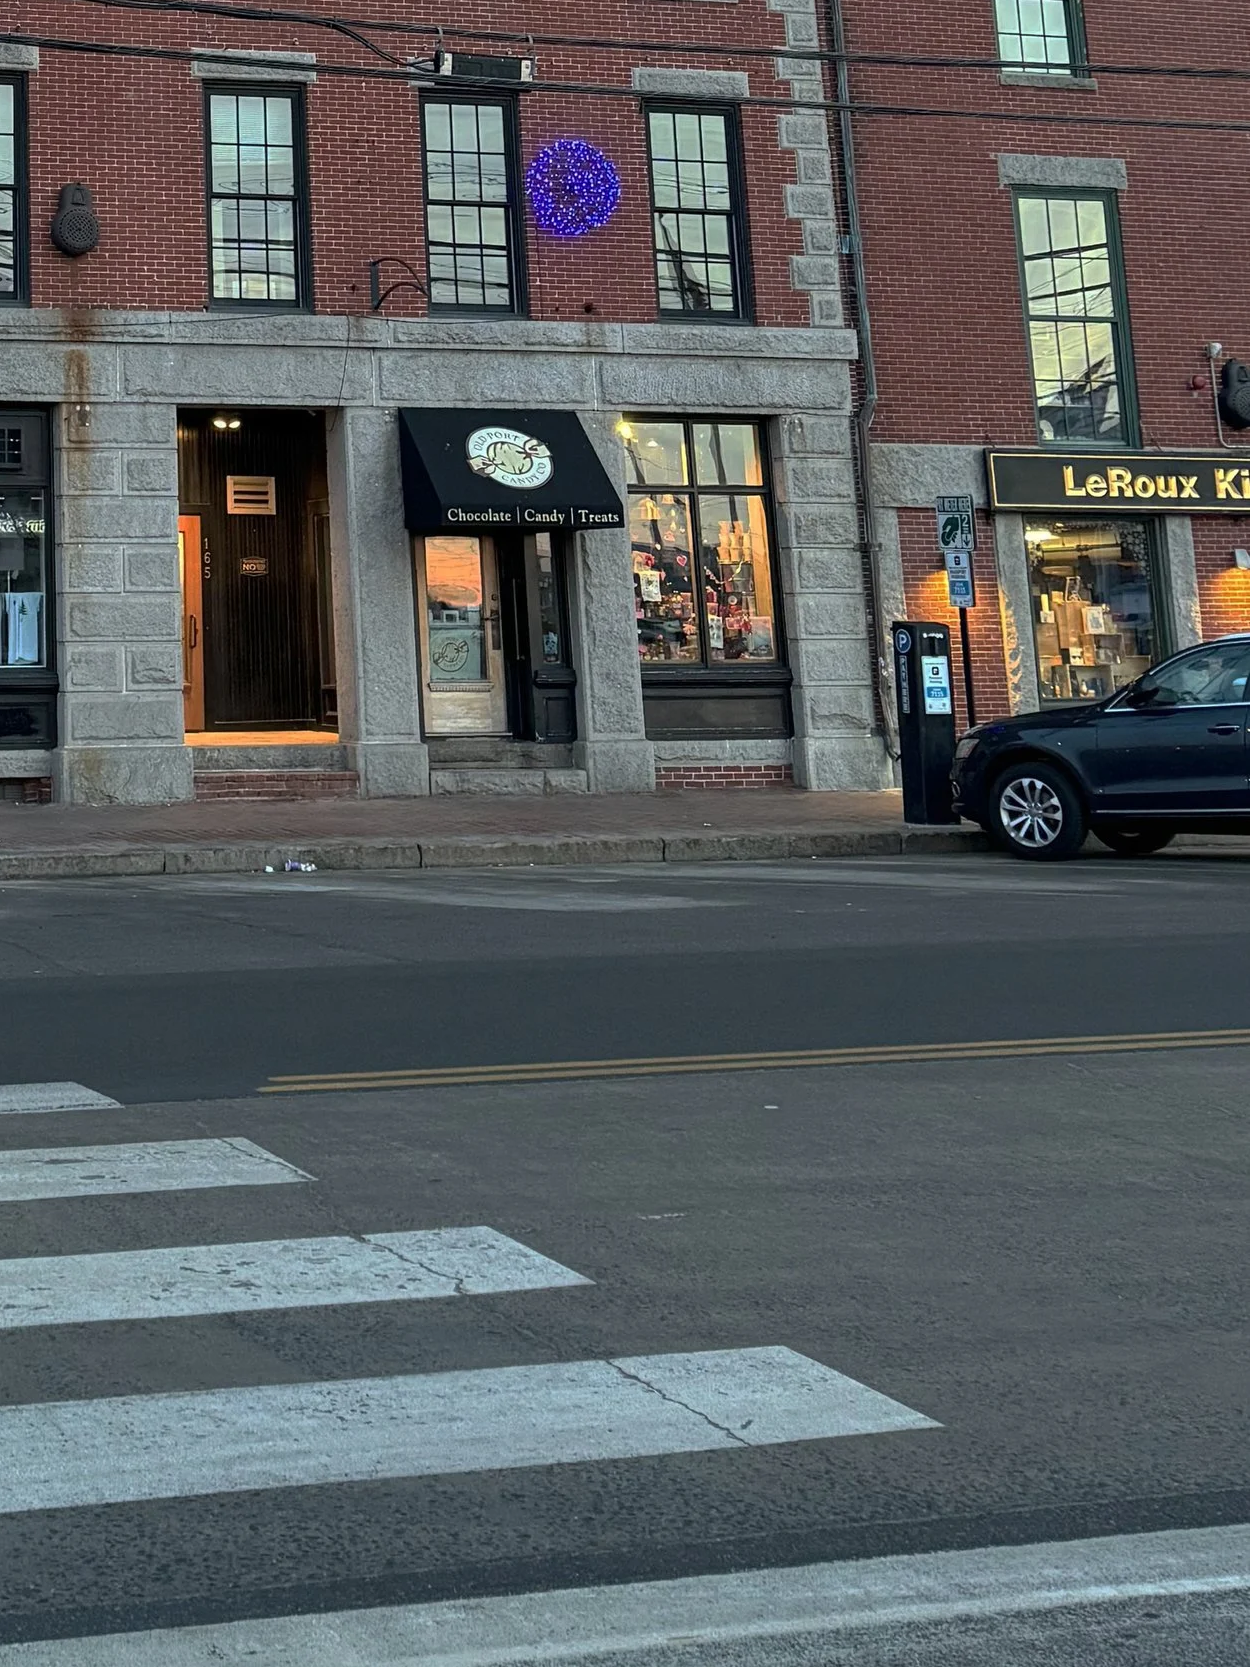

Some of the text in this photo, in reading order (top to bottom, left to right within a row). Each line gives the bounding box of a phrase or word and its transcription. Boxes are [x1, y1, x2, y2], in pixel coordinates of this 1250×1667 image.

[474, 431, 520, 451] OLD PORT
[501, 472, 540, 485] CANDY
[1063, 465, 1200, 499] LeRoux
[447, 507, 620, 524] Chocolate Candy Treats
[961, 514, 969, 527] 2
[203, 537, 211, 579] 165
[898, 634, 907, 648] P
